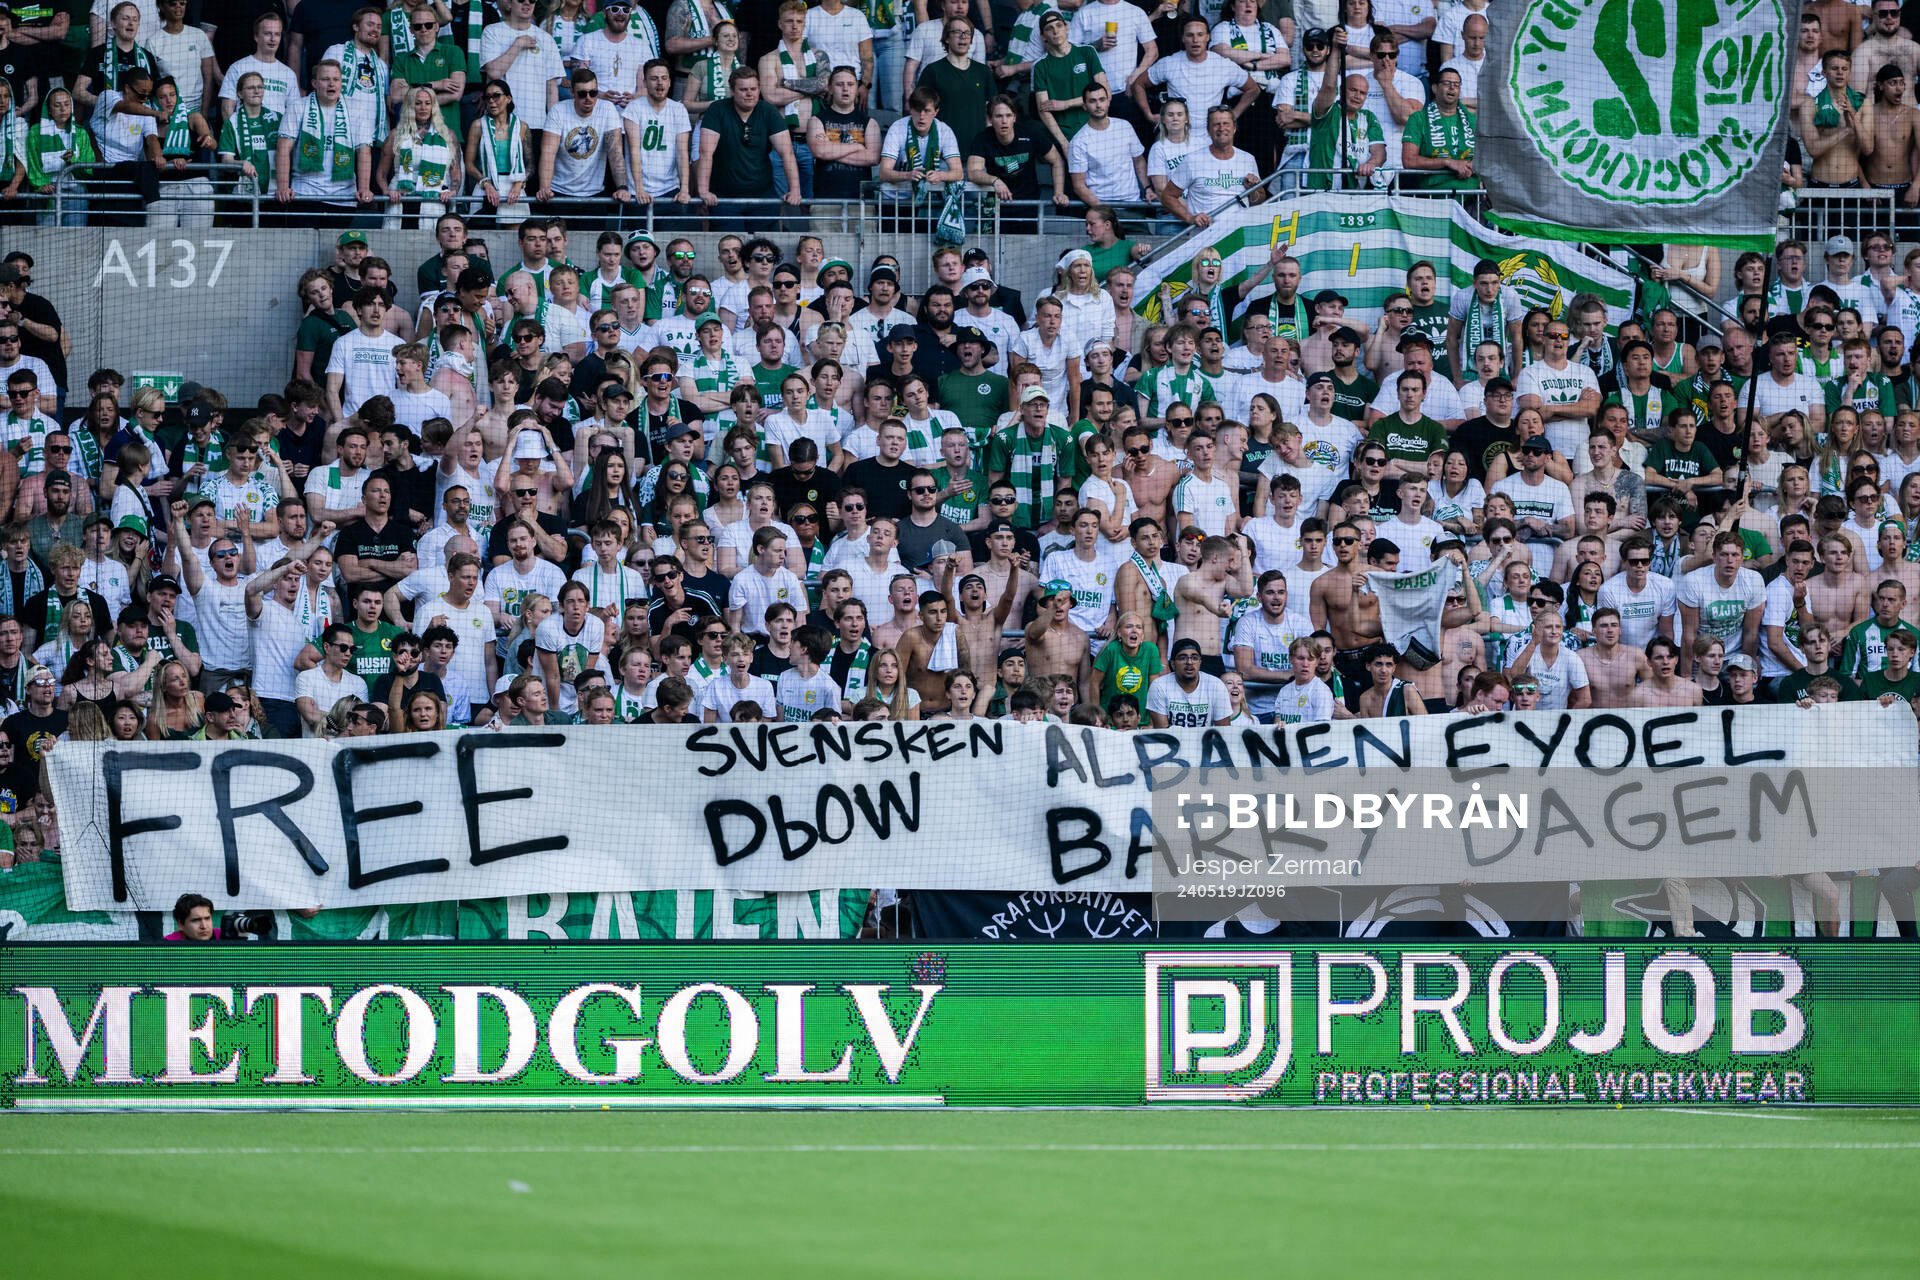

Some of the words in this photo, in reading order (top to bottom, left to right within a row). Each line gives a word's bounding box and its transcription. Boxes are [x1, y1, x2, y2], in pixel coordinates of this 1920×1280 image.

[642, 119, 667, 152] ÖL
[1340, 215, 1376, 226] 1889
[1270, 211, 1299, 250] H
[94, 238, 235, 289] A137
[662, 300, 677, 310] SIE
[1419, 316, 1449, 327] AJEN
[1540, 377, 1584, 391] HUDDINGE
[763, 394, 786, 406] HUS
[1245, 450, 1272, 463] BAJ
[1665, 458, 1699, 476] TULLINGE
[1394, 570, 1437, 590] BAJEN
[1867, 644, 1885, 655] SIE
[356, 656, 390, 669] HUSKI
[1169, 703, 1209, 714] HAMMARBY
[1169, 711, 1208, 728] 1897
[686, 721, 1003, 776] SVENSKEN
[1045, 718, 1411, 793] ALBANEN
[1445, 708, 1787, 784] EYOEL
[103, 733, 569, 902] FREE
[1462, 770, 1818, 866] DAGEM
[1316, 951, 1807, 1056] PROJOB
[13, 983, 943, 1086] METODGOLV
[1317, 1071, 1585, 1102] PROFESSIONAL
[1594, 1071, 1805, 1102] WORKWEAR
